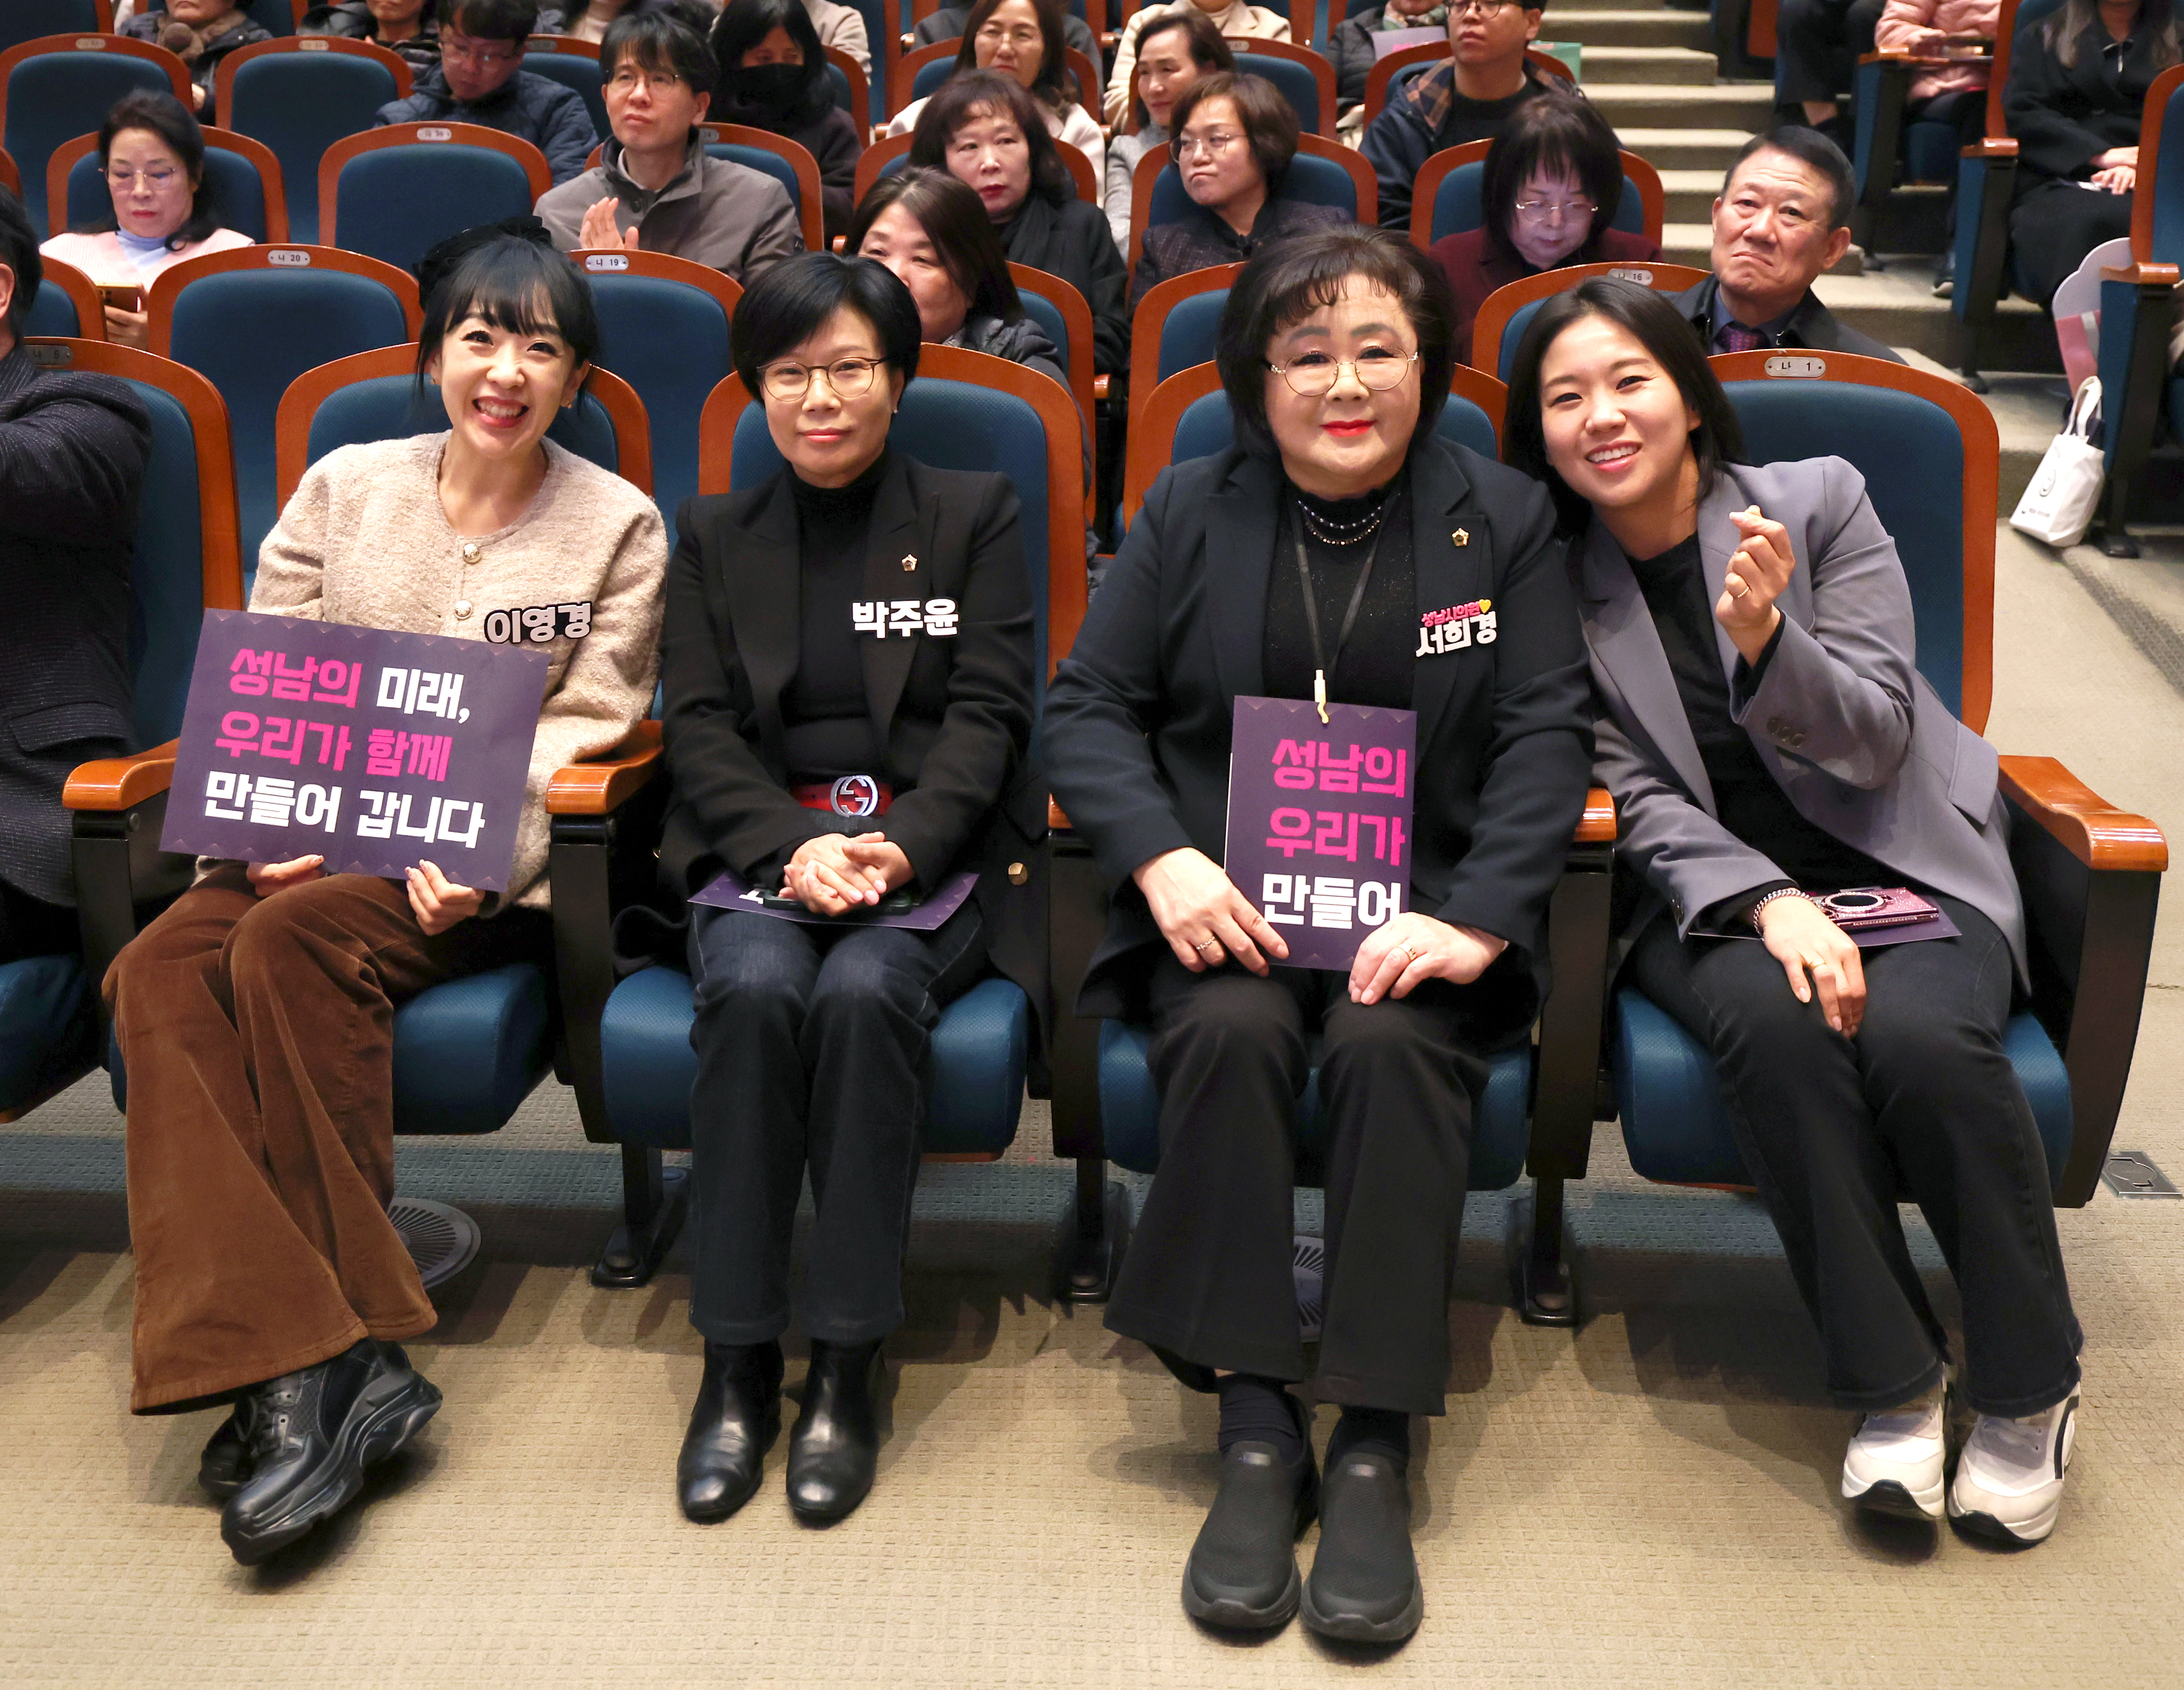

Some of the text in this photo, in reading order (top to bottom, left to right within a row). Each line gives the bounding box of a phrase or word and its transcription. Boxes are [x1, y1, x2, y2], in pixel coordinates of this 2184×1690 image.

[1806, 362, 1811, 371] 1
[487, 602, 591, 644] 이영경
[852, 599, 959, 639] 박주윤
[1415, 610, 1497, 658] 서희경
[1421, 601, 1481, 627] 성남시의원
[229, 648, 470, 724] 성남의 미래,
[214, 710, 453, 782] 우리가 함께
[1271, 738, 1407, 798] 성남의
[205, 771, 486, 849] 만들어 갑니다
[1265, 807, 1406, 866] 우리가
[1262, 873, 1401, 930] 만들어
